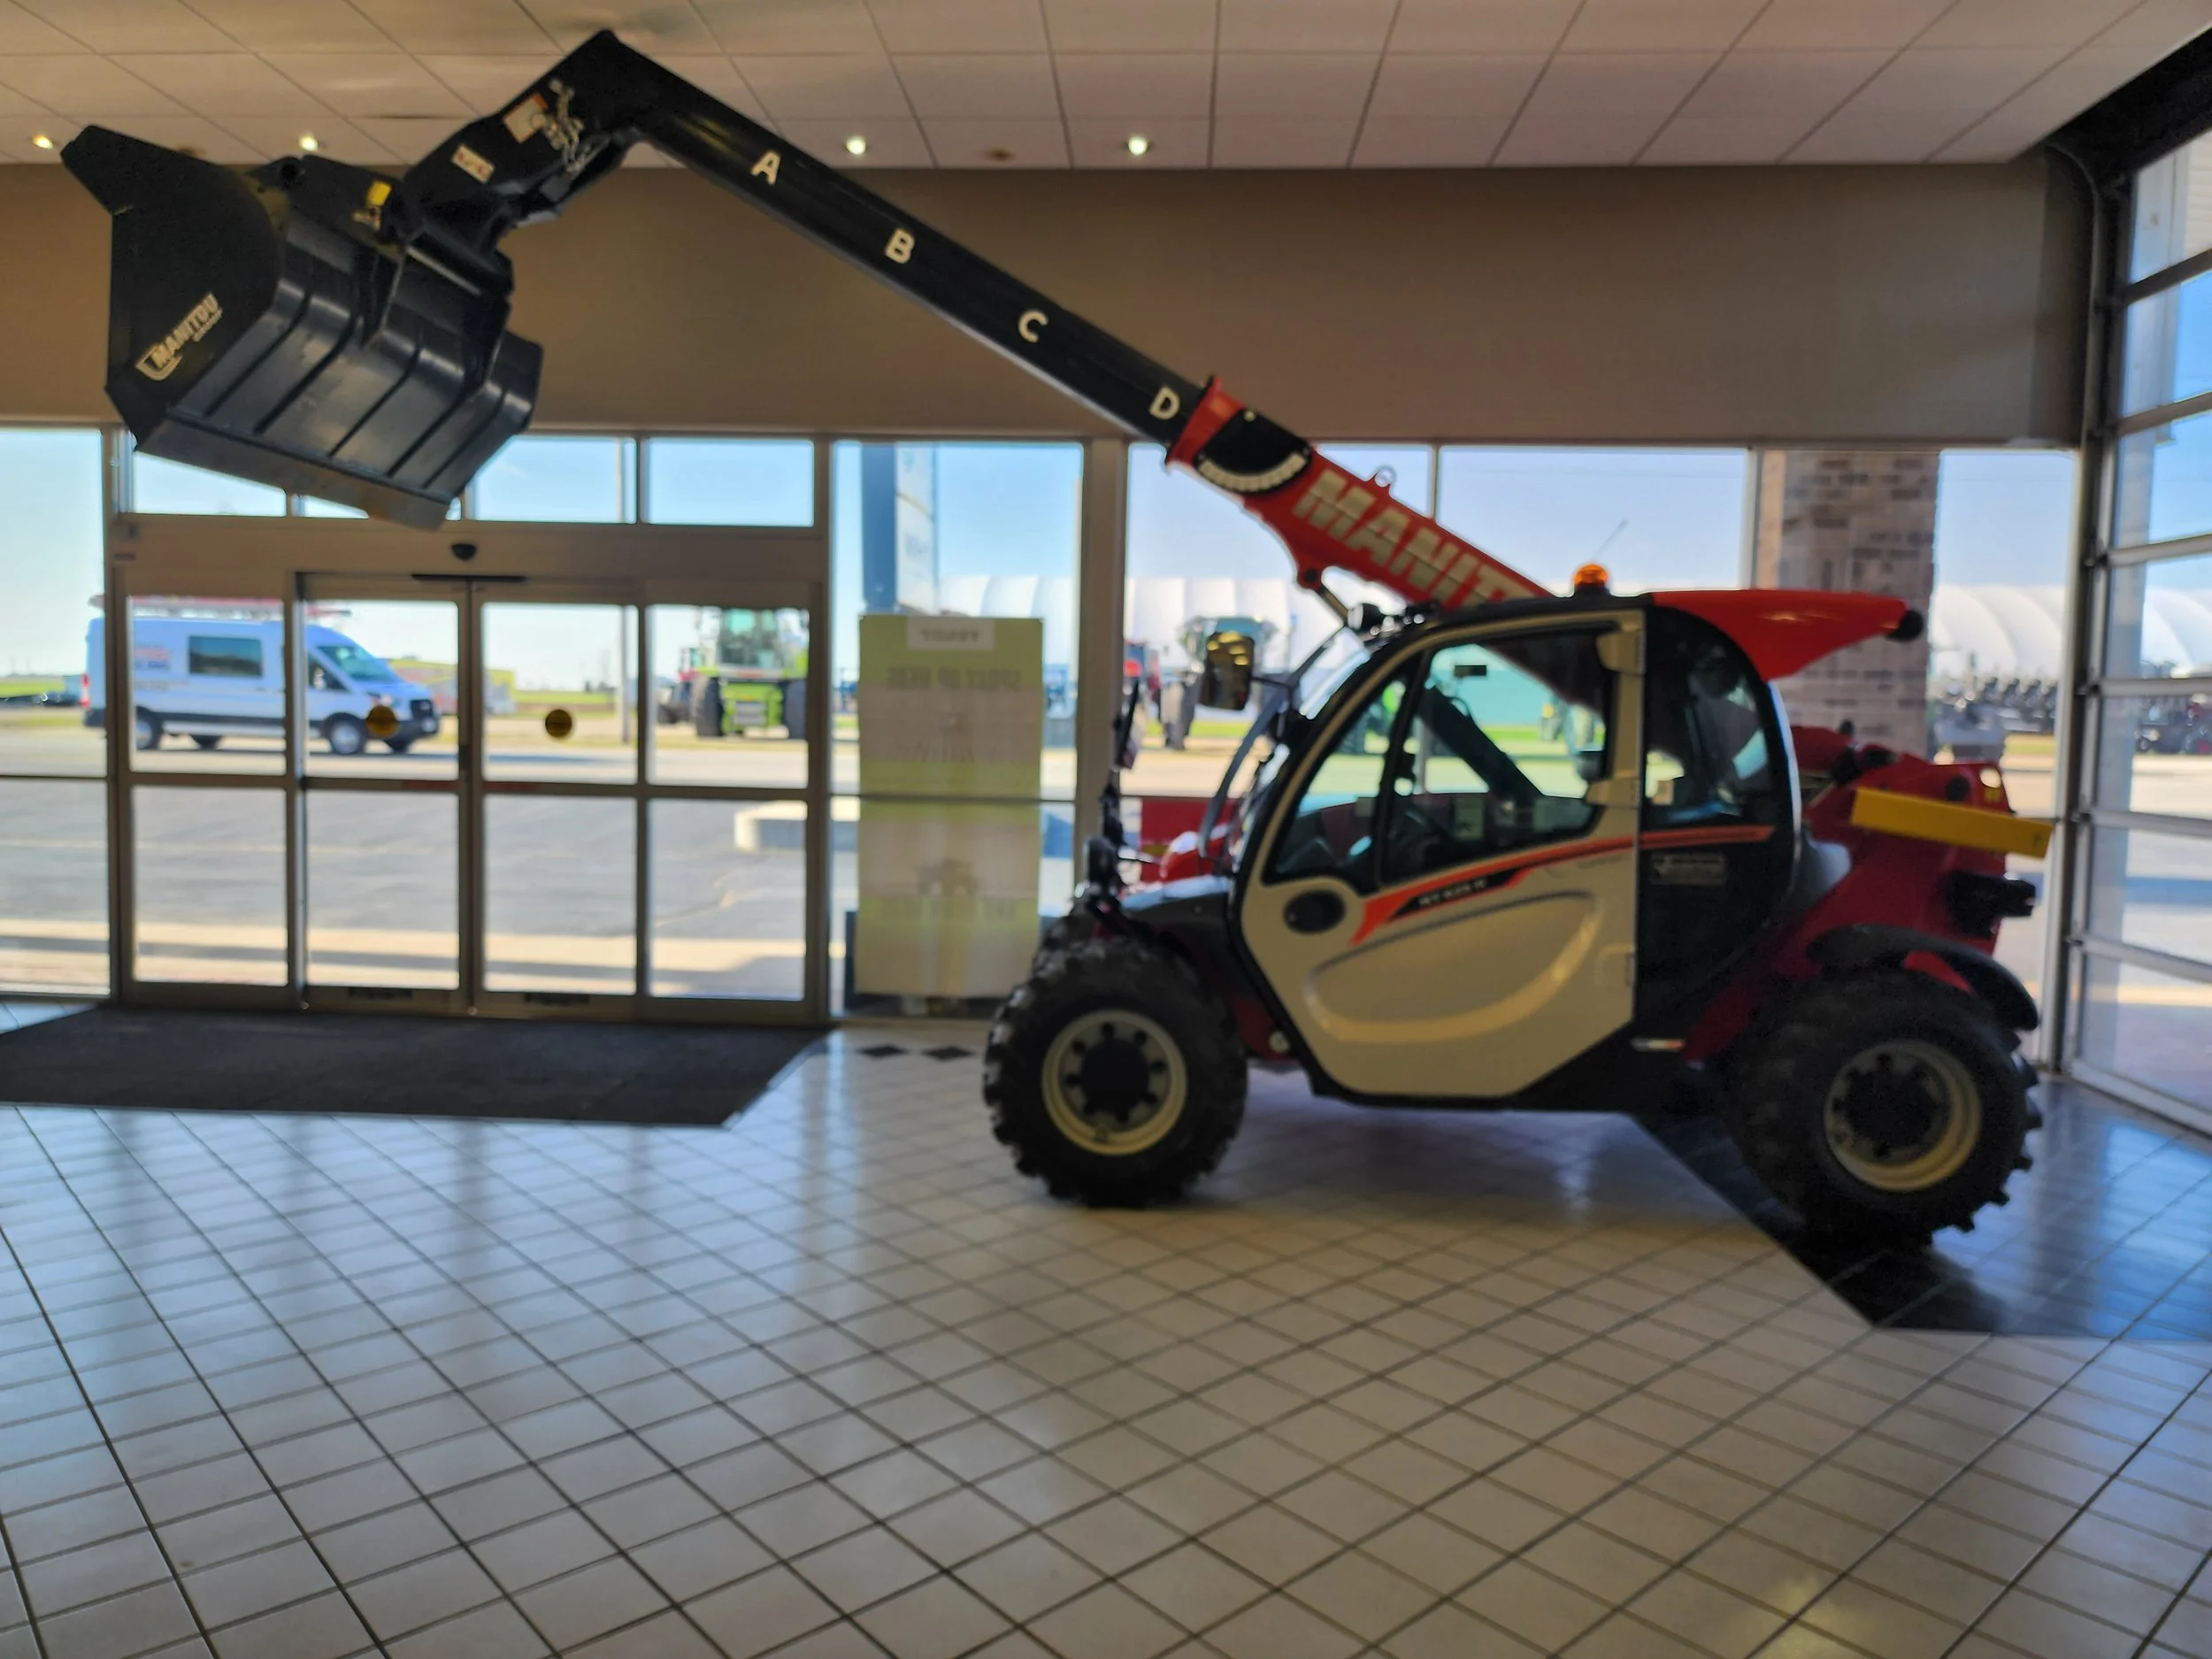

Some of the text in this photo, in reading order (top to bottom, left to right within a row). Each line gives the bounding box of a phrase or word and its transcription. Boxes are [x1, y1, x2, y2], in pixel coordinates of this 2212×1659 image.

[751, 150, 781, 184] A
[886, 228, 915, 264] B
[149, 291, 219, 370] MANITOU
[1018, 310, 1048, 342] C
[1149, 386, 1179, 420] D
[1292, 467, 1537, 609] MANIT
